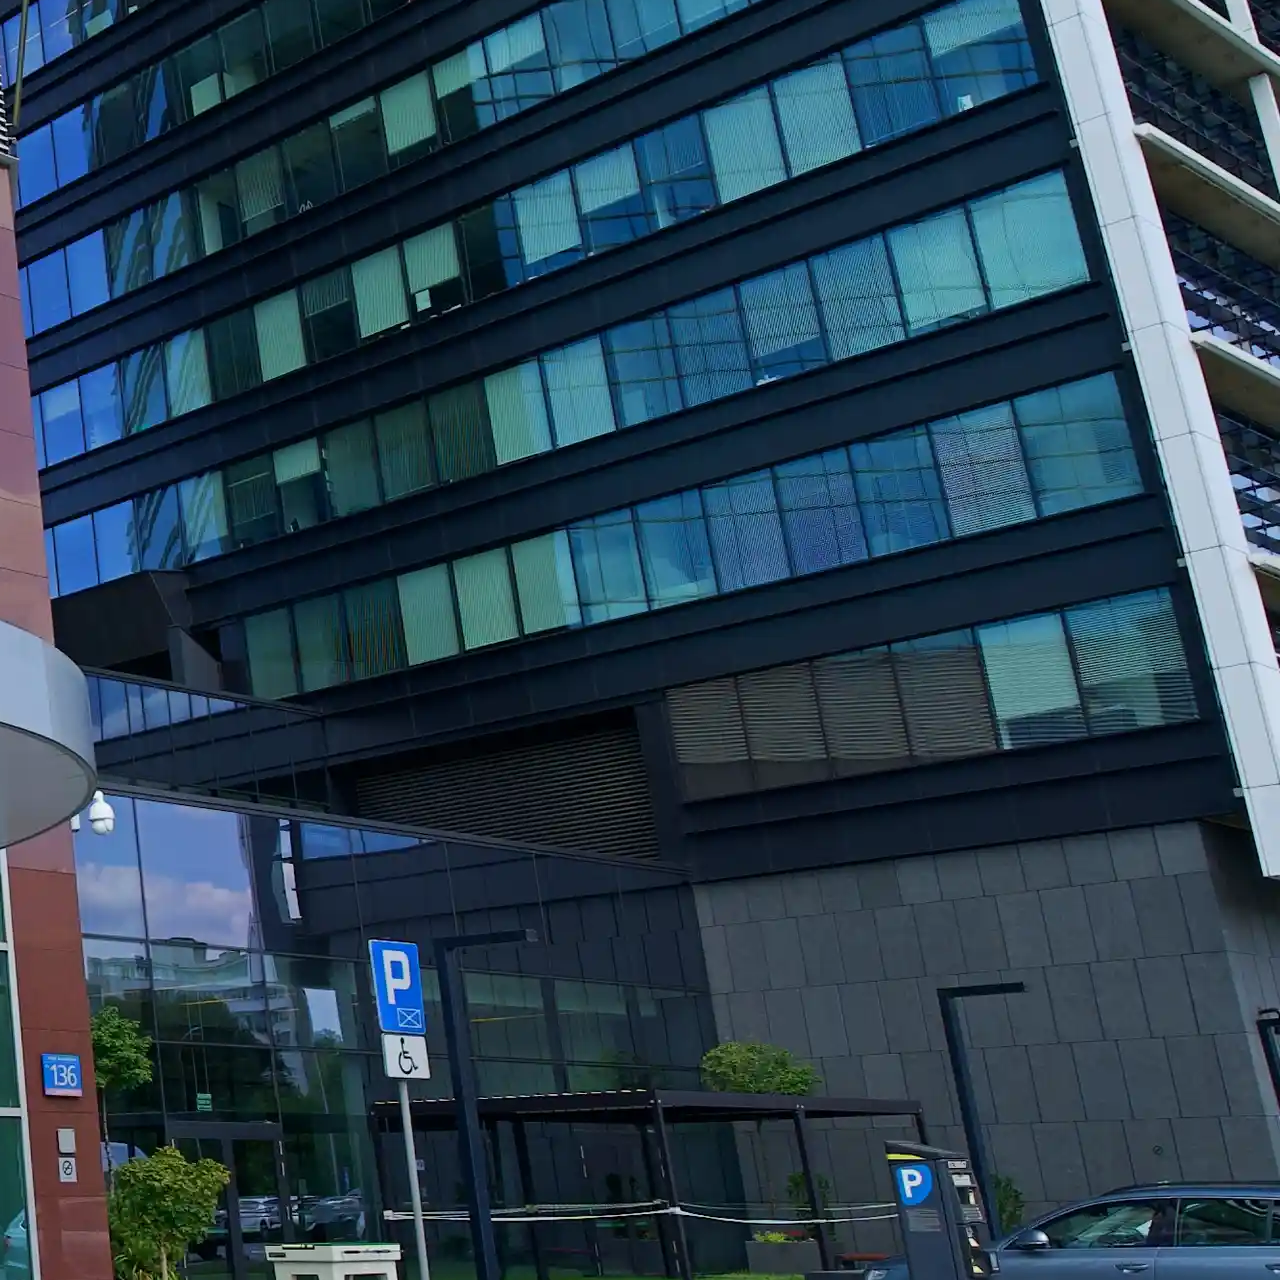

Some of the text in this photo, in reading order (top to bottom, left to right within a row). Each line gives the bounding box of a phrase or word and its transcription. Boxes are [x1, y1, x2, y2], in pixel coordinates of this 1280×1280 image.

[382, 949, 411, 1005] P
[50, 1063, 78, 1087] 136
[900, 1168, 923, 1198] P
